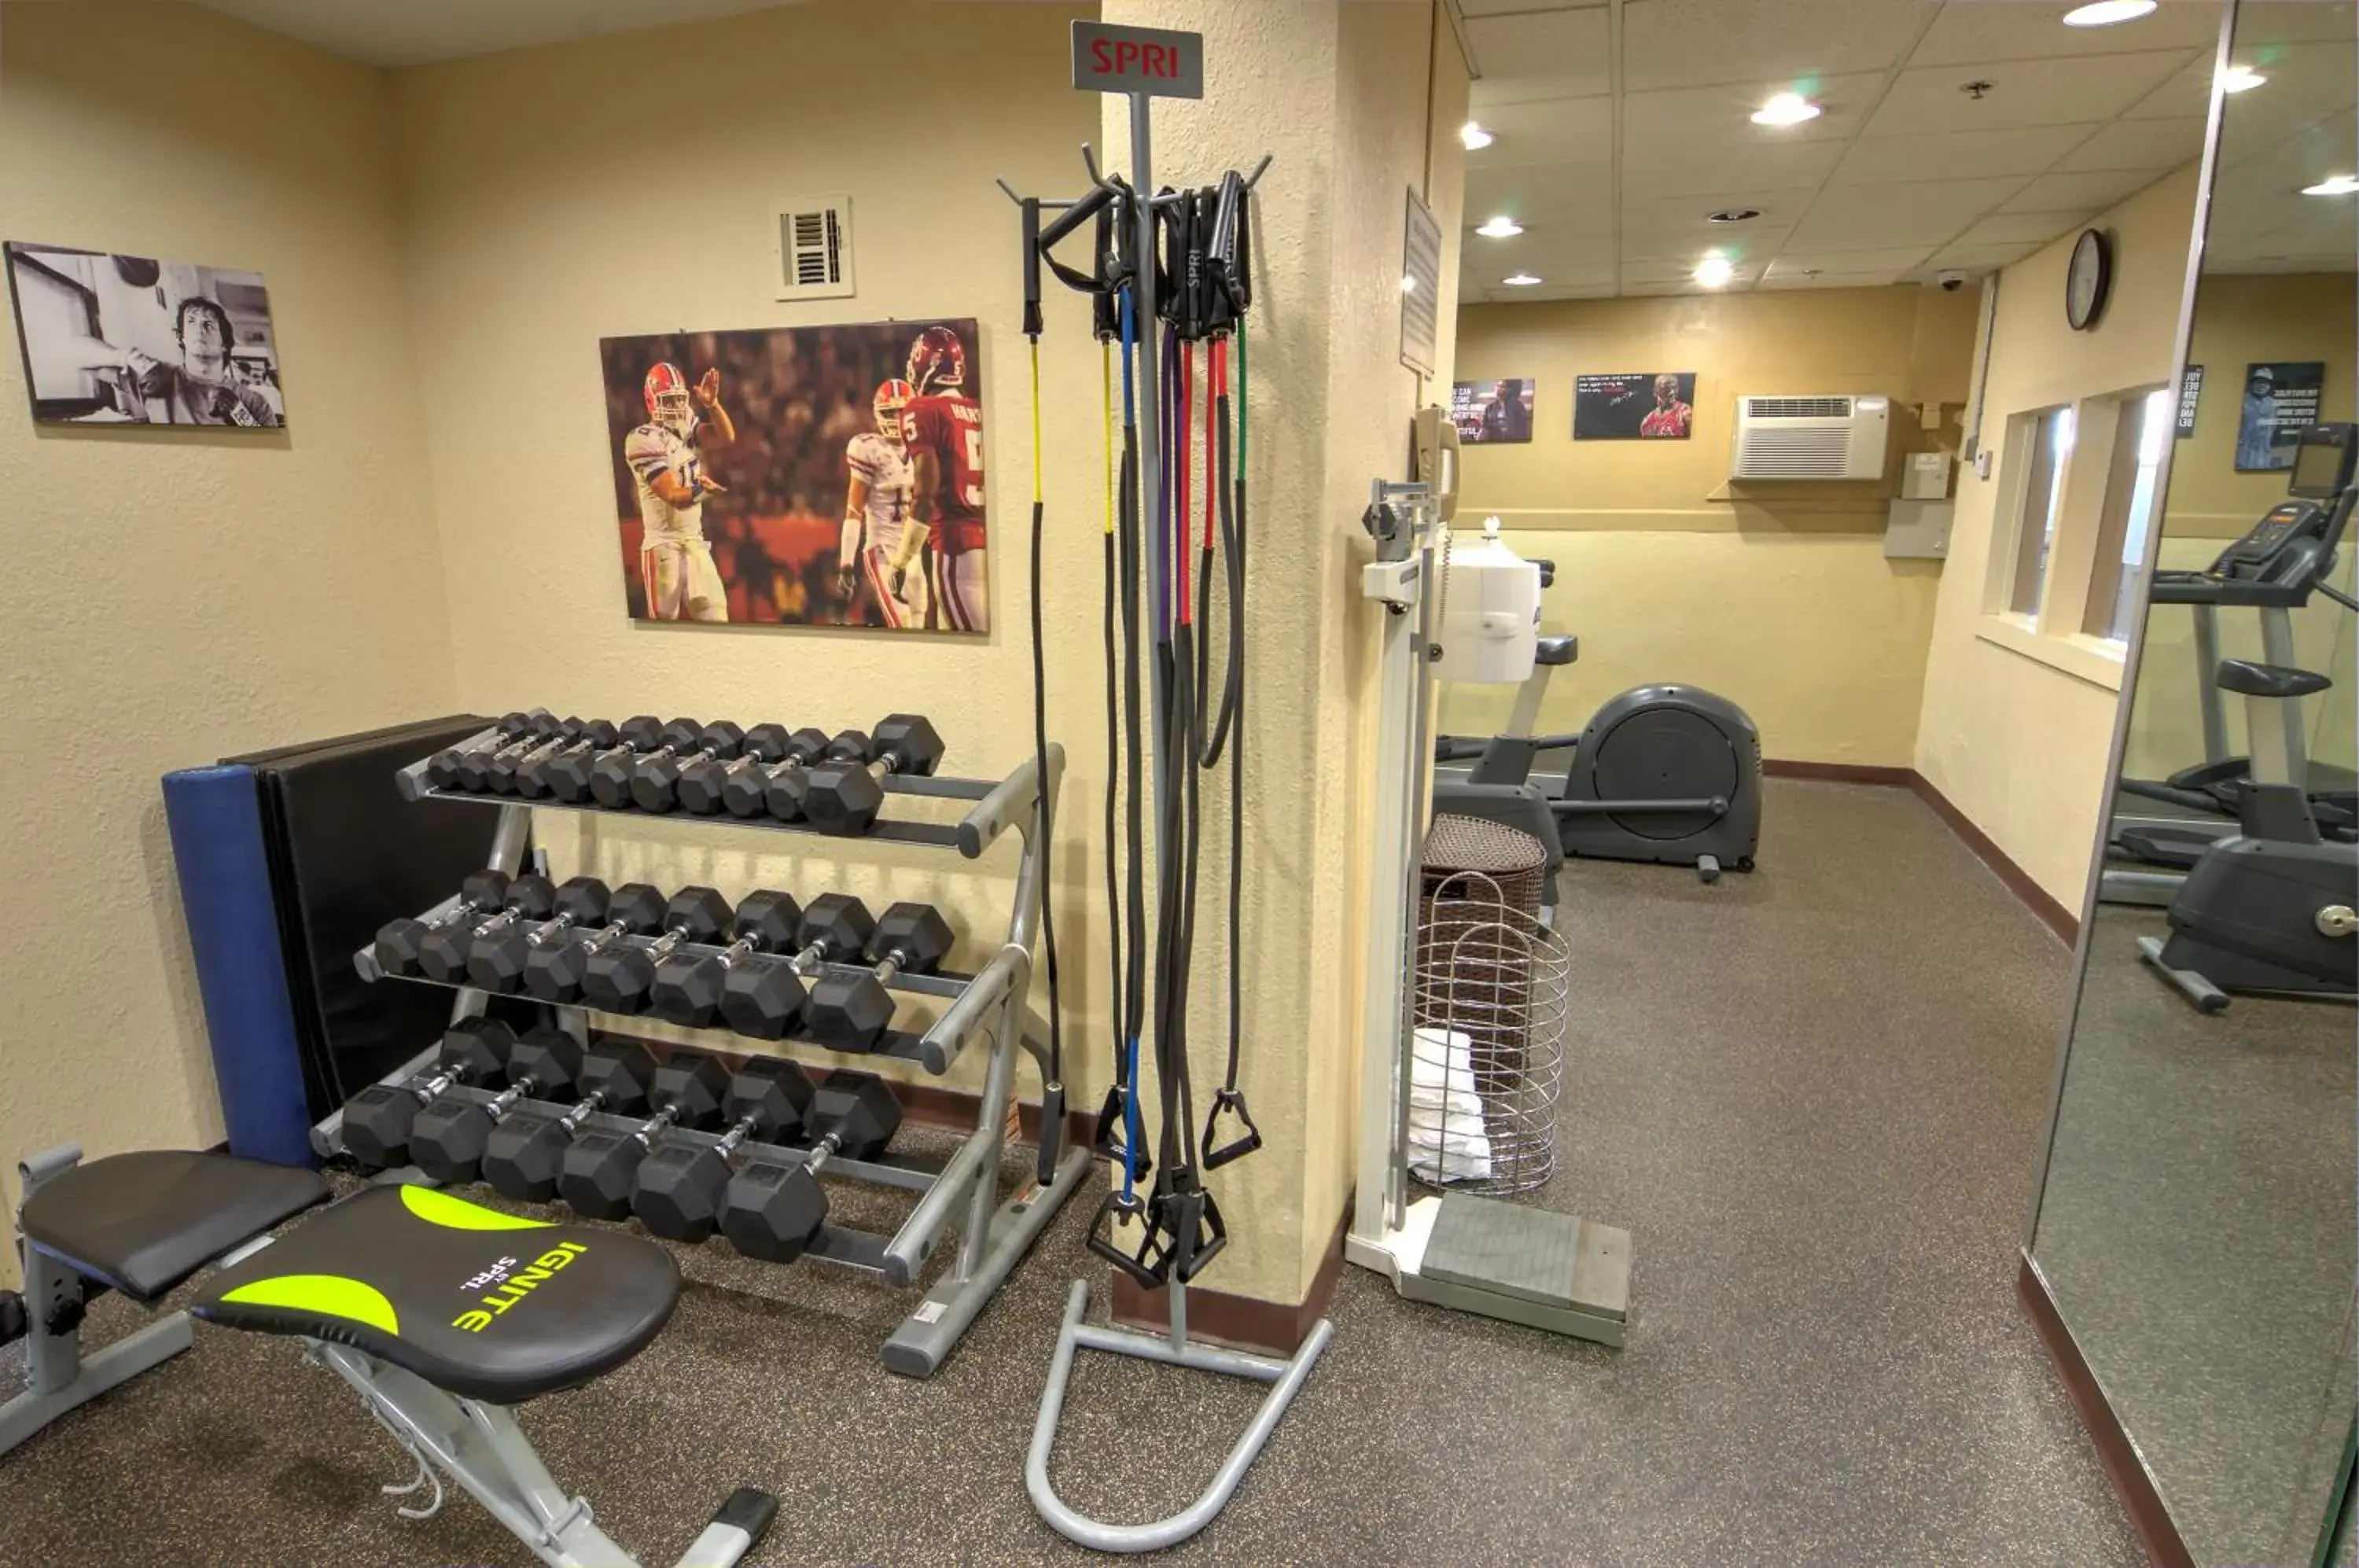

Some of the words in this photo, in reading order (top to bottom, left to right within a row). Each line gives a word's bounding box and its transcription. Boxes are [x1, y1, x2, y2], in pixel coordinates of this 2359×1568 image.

[1091, 37, 1179, 78] SPRI
[1187, 248, 1202, 289] SPRI
[903, 412, 918, 442] 5
[451, 1242, 588, 1333] IGNITE
